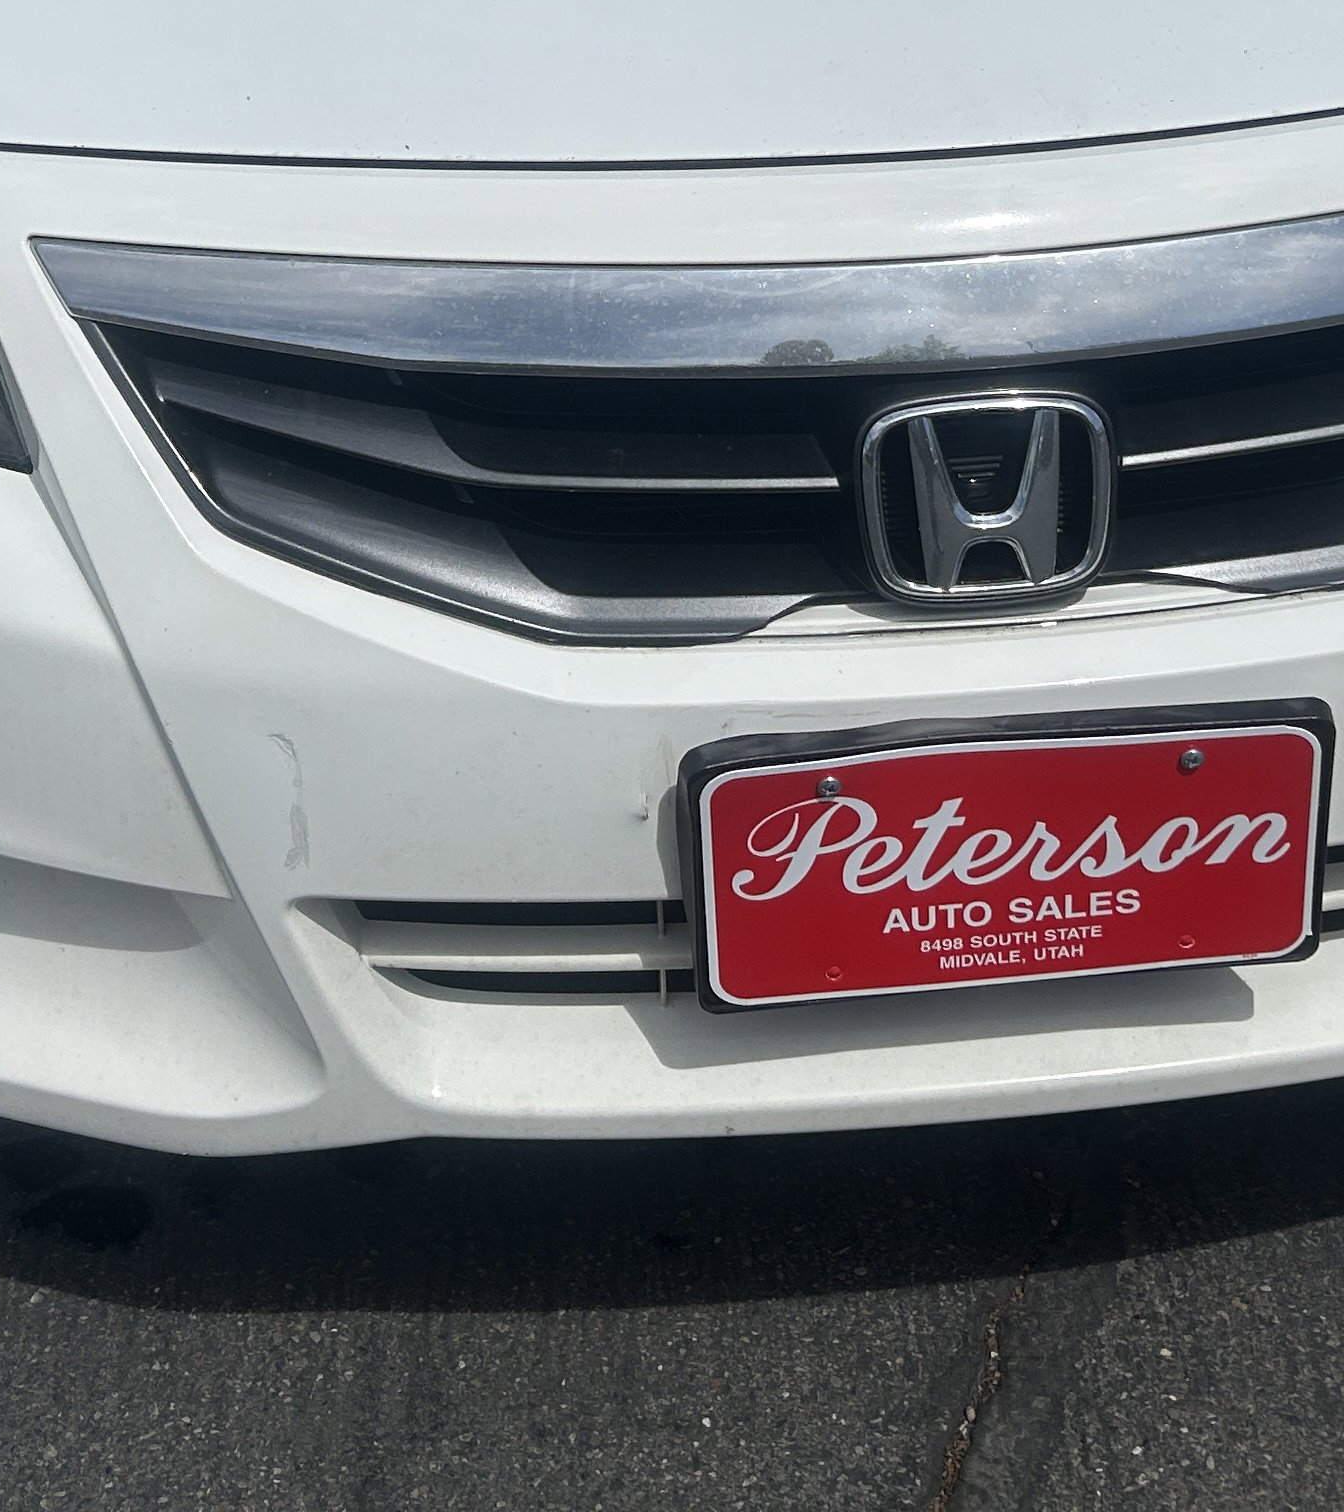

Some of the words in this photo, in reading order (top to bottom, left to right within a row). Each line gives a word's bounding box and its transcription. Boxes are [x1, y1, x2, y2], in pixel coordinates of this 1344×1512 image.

[730, 795, 1292, 902] Peterson
[883, 899, 992, 935] AUTO
[1007, 888, 1142, 923] SALES
[919, 935, 964, 953] 8498
[969, 930, 1038, 948] SOUTH
[1043, 925, 1104, 943] STATE
[938, 948, 1028, 971] MIDVALE,
[1032, 943, 1085, 963] UTAH
